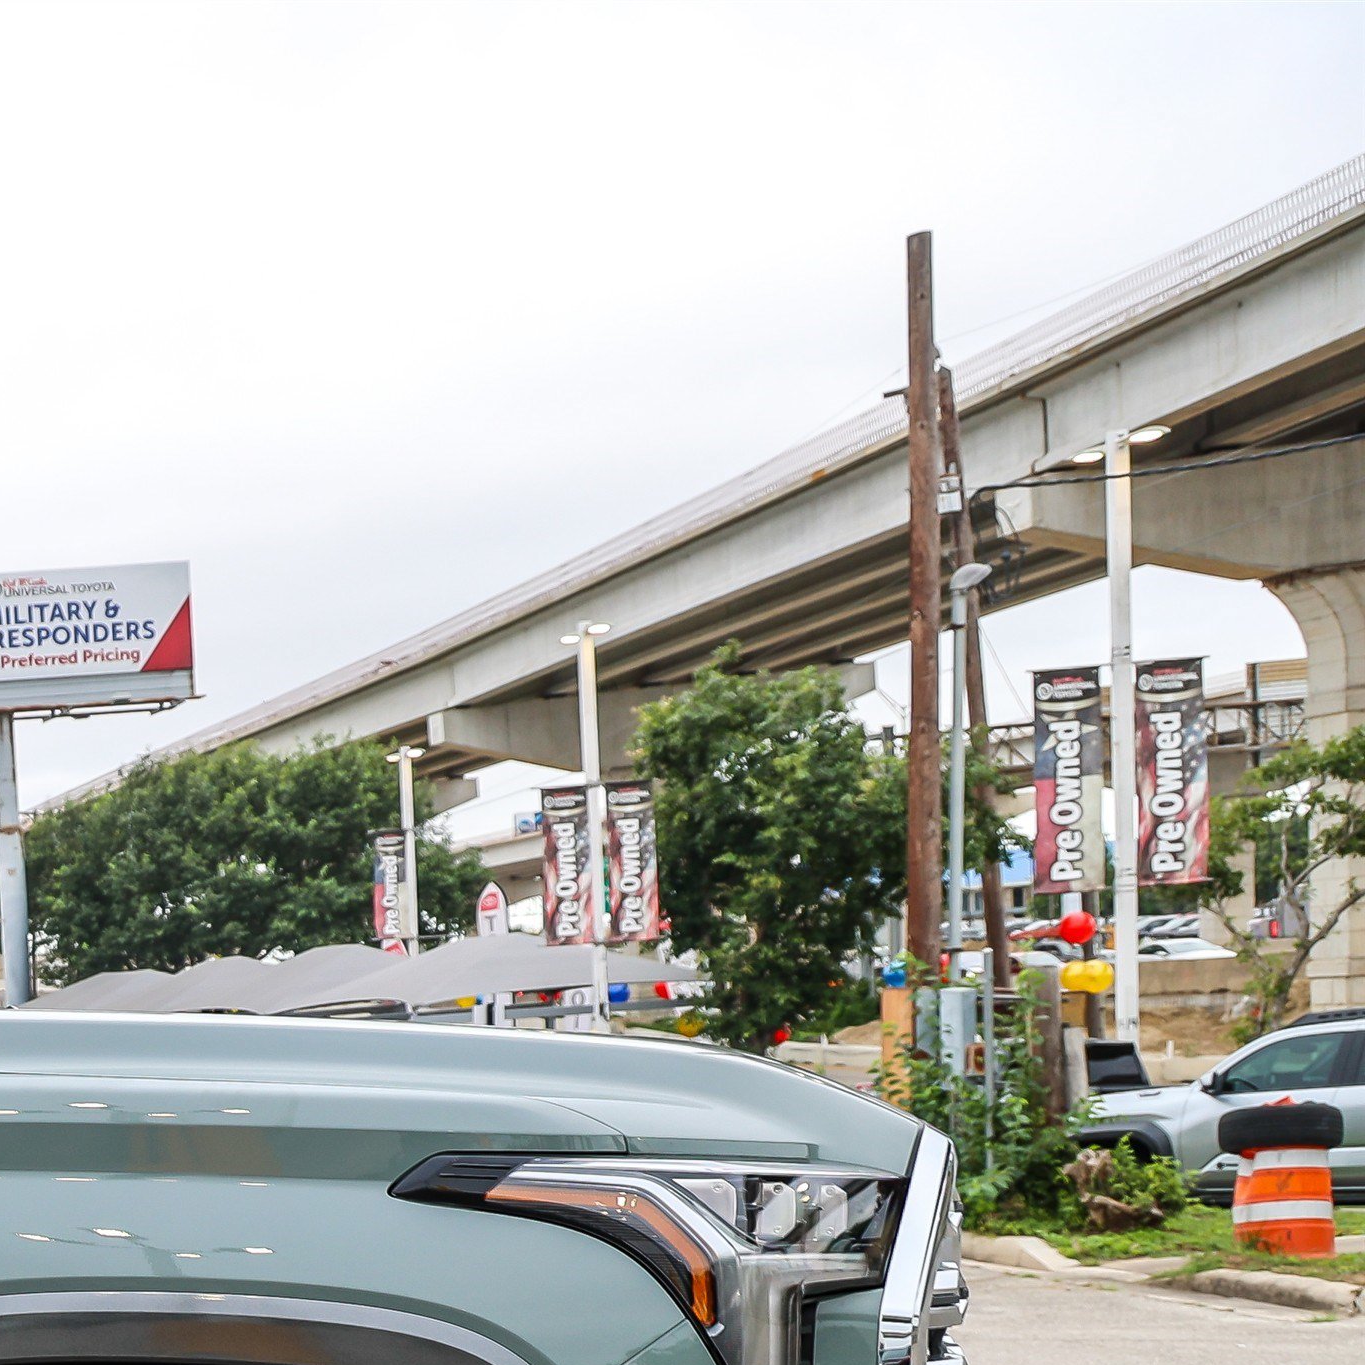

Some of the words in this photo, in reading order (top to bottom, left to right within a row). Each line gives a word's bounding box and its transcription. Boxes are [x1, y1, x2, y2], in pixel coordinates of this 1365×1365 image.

[4, 584, 69, 597] UNIVERSAL
[71, 581, 116, 593] TOYOTA
[105, 599, 120, 618] &
[1, 650, 79, 669] Preferred
[83, 647, 141, 665] Pricing
[1049, 720, 1084, 826] Owned
[1149, 711, 1185, 818] Owned
[552, 822, 578, 897] Owned
[617, 818, 643, 894] Owned
[1050, 829, 1085, 881] Pre
[1150, 820, 1185, 874] Pre
[556, 901, 581, 937] Pre
[619, 897, 645, 933] Pre
